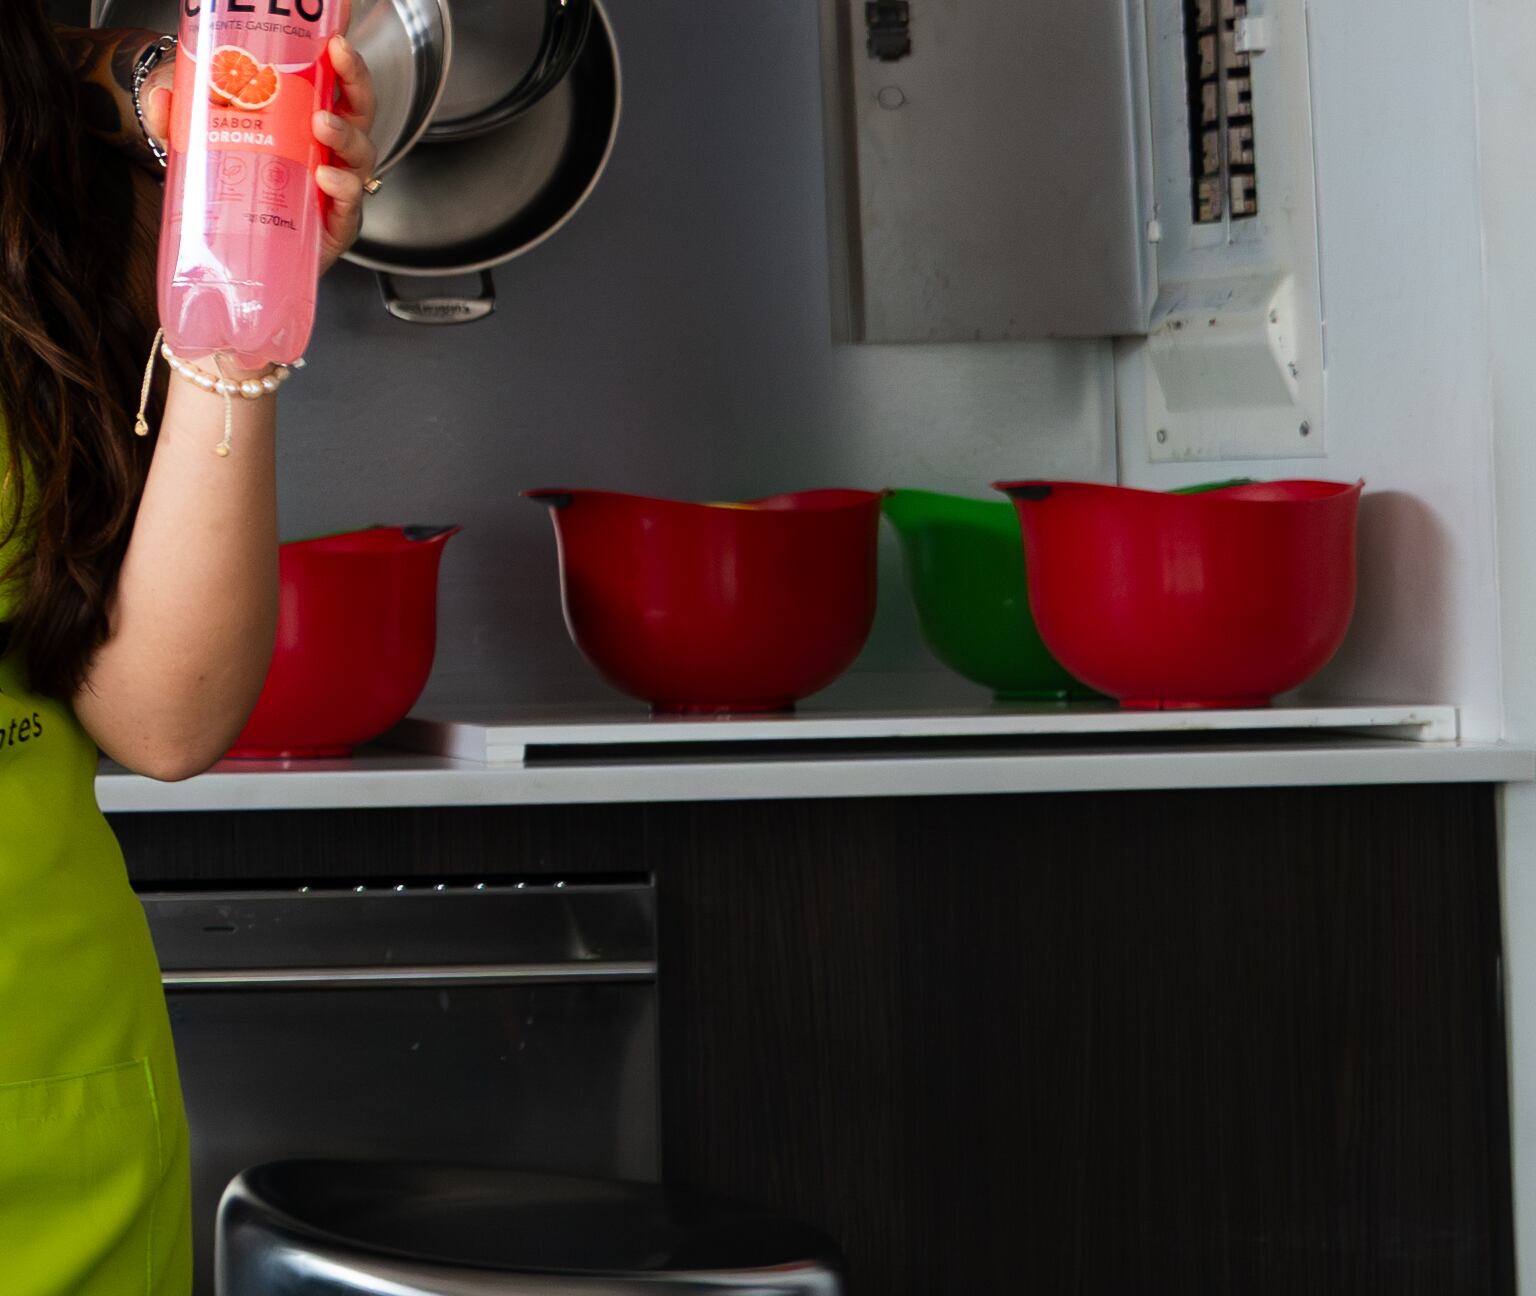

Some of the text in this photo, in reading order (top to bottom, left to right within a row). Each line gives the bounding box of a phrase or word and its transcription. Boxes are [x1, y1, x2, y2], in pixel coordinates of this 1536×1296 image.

[245, 20, 312, 39] GASIFICADA
[212, 117, 264, 131] SABOR
[206, 130, 274, 146] ORONJA
